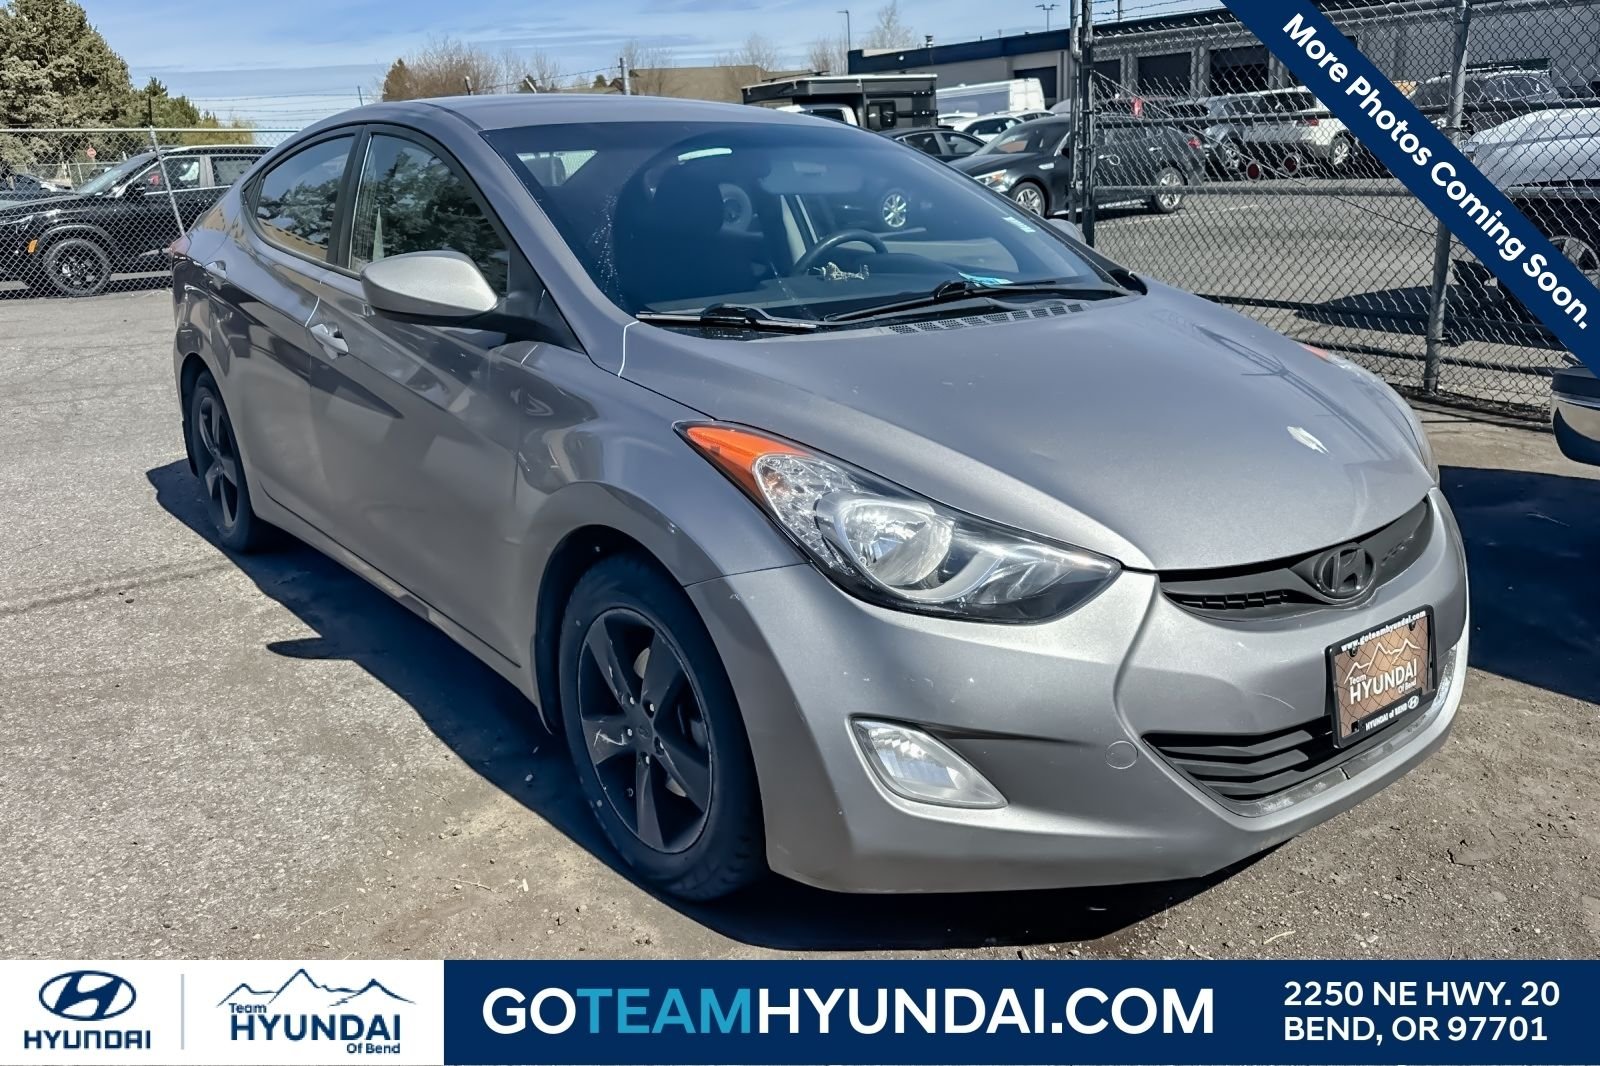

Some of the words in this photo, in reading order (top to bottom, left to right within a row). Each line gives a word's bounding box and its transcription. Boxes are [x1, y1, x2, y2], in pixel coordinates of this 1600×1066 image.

[1348, 674, 1367, 686] Team
[1350, 658, 1417, 704] HYUNDAI
[1365, 712, 1389, 732] HYUNDAI
